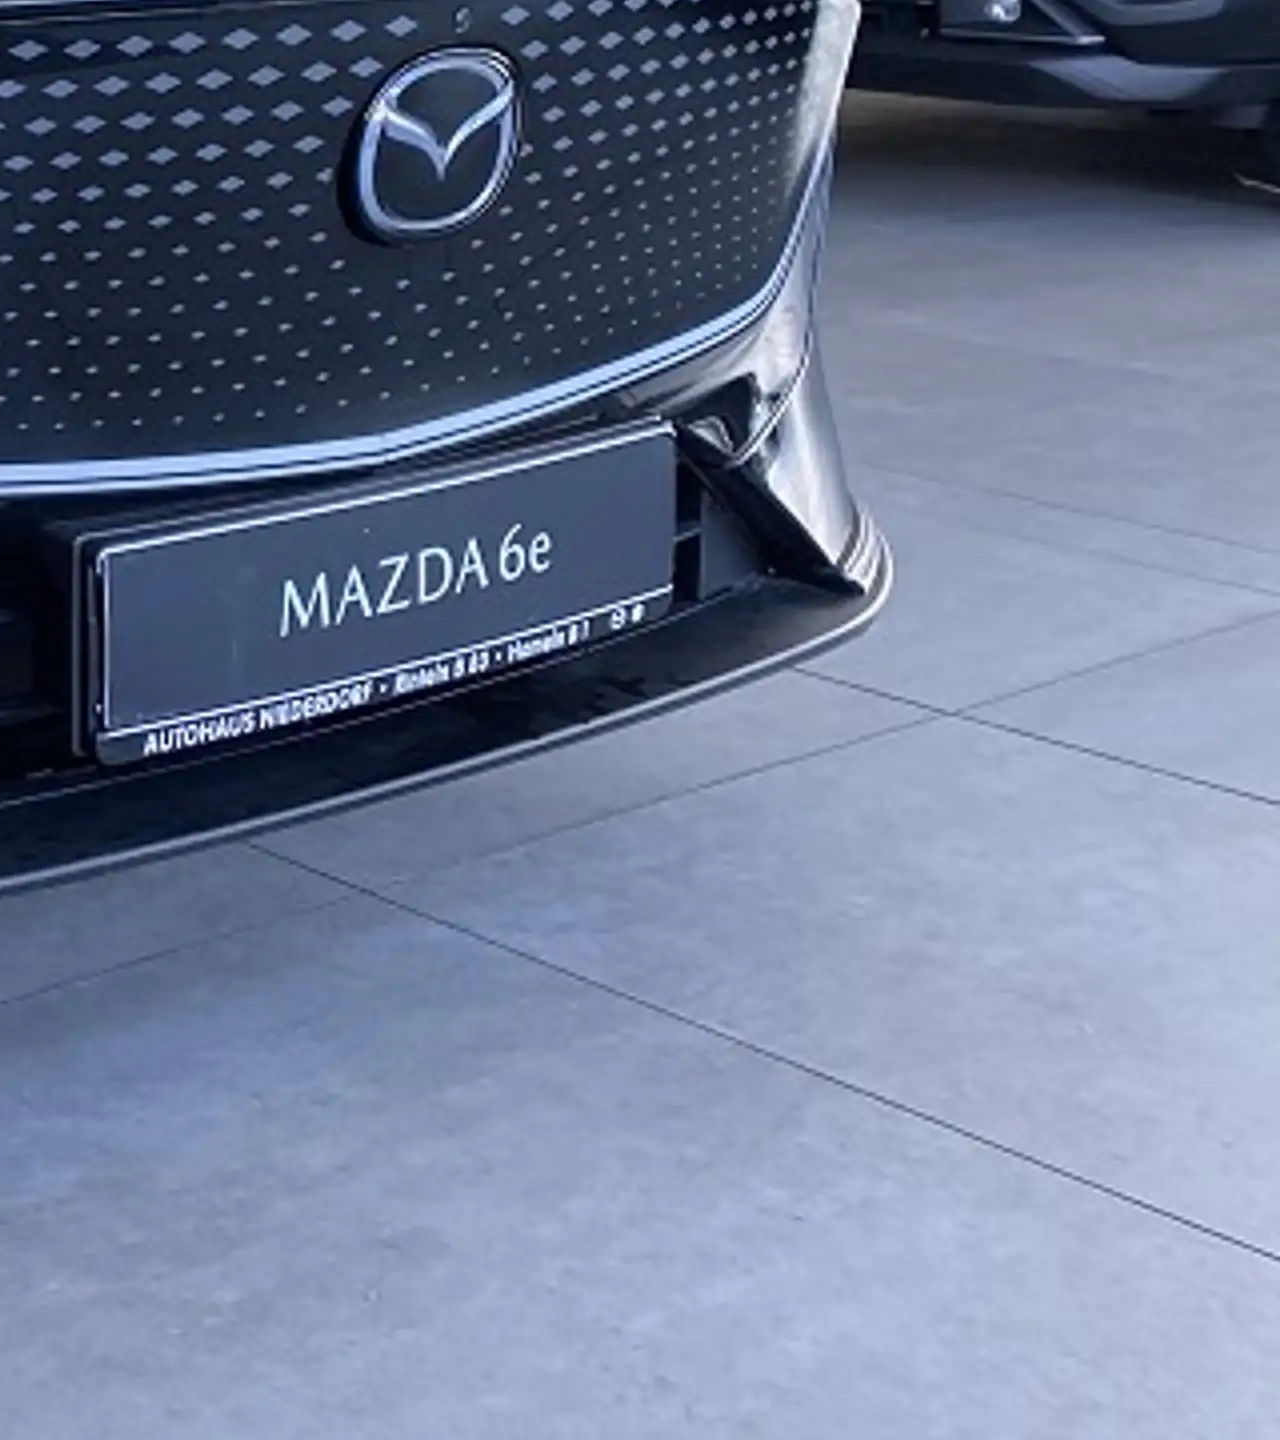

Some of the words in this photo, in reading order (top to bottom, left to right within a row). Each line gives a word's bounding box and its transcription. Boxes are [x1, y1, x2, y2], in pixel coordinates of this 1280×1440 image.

[279, 536, 489, 638] MAZDA
[498, 522, 552, 582] 6e
[143, 710, 255, 756] AUTOHAUS
